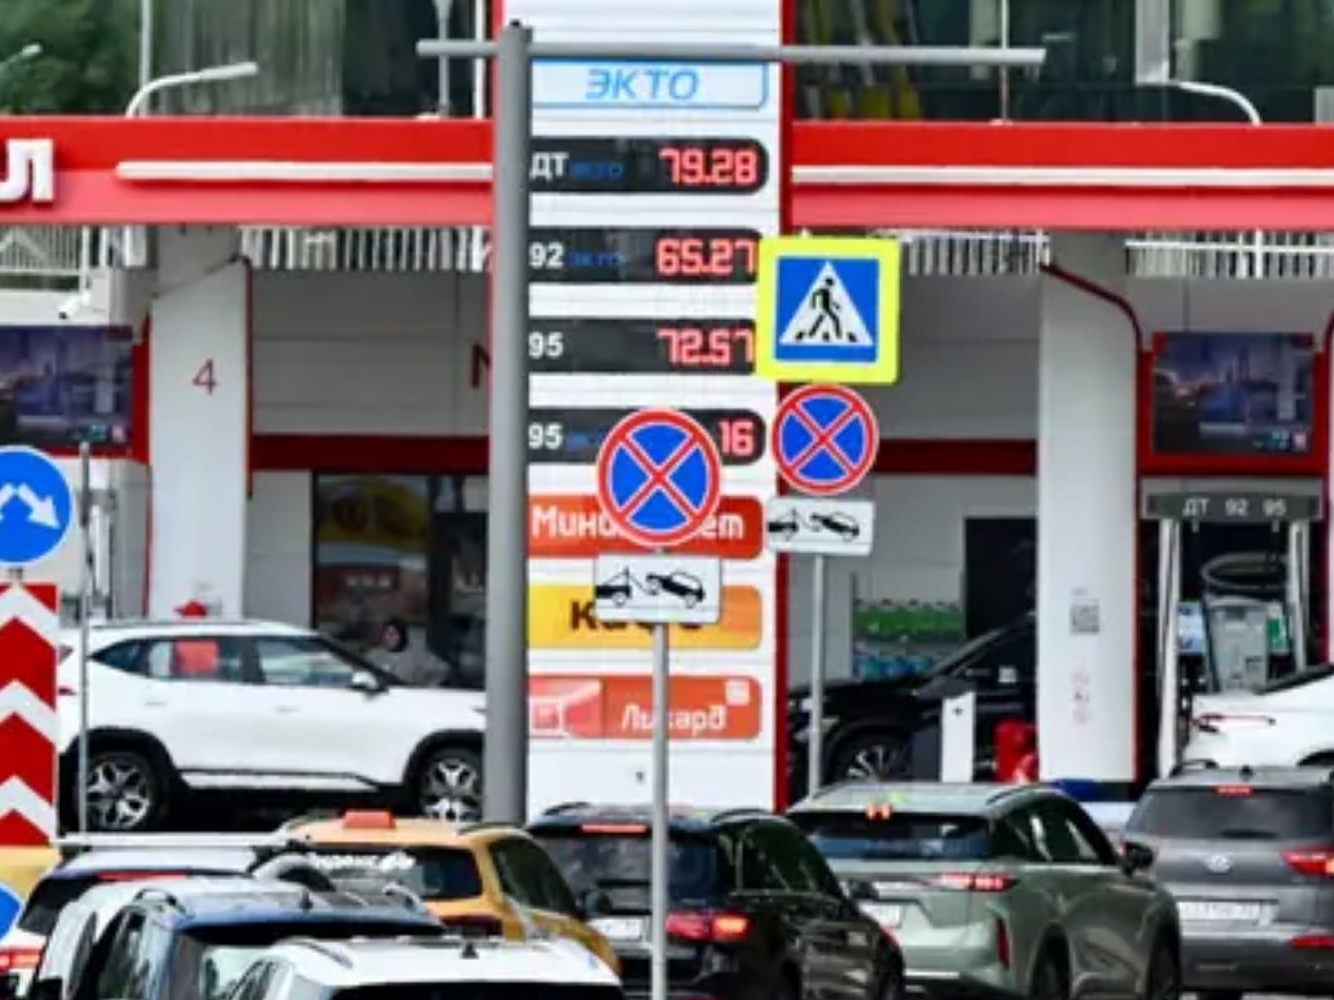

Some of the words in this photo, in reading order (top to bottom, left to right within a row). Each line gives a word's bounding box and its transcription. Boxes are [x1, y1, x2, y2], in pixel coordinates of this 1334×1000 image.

[585, 68, 700, 101] ЭКТО
[530, 152, 569, 181] ДТ
[660, 148, 758, 186] 79.28
[529, 243, 564, 269] 92
[657, 239, 756, 277] 65.27
[528, 332, 563, 359] 95
[657, 328, 755, 367] 72.57
[192, 358, 218, 396] 4
[528, 423, 563, 450] 95
[621, 704, 727, 737] Лиард
